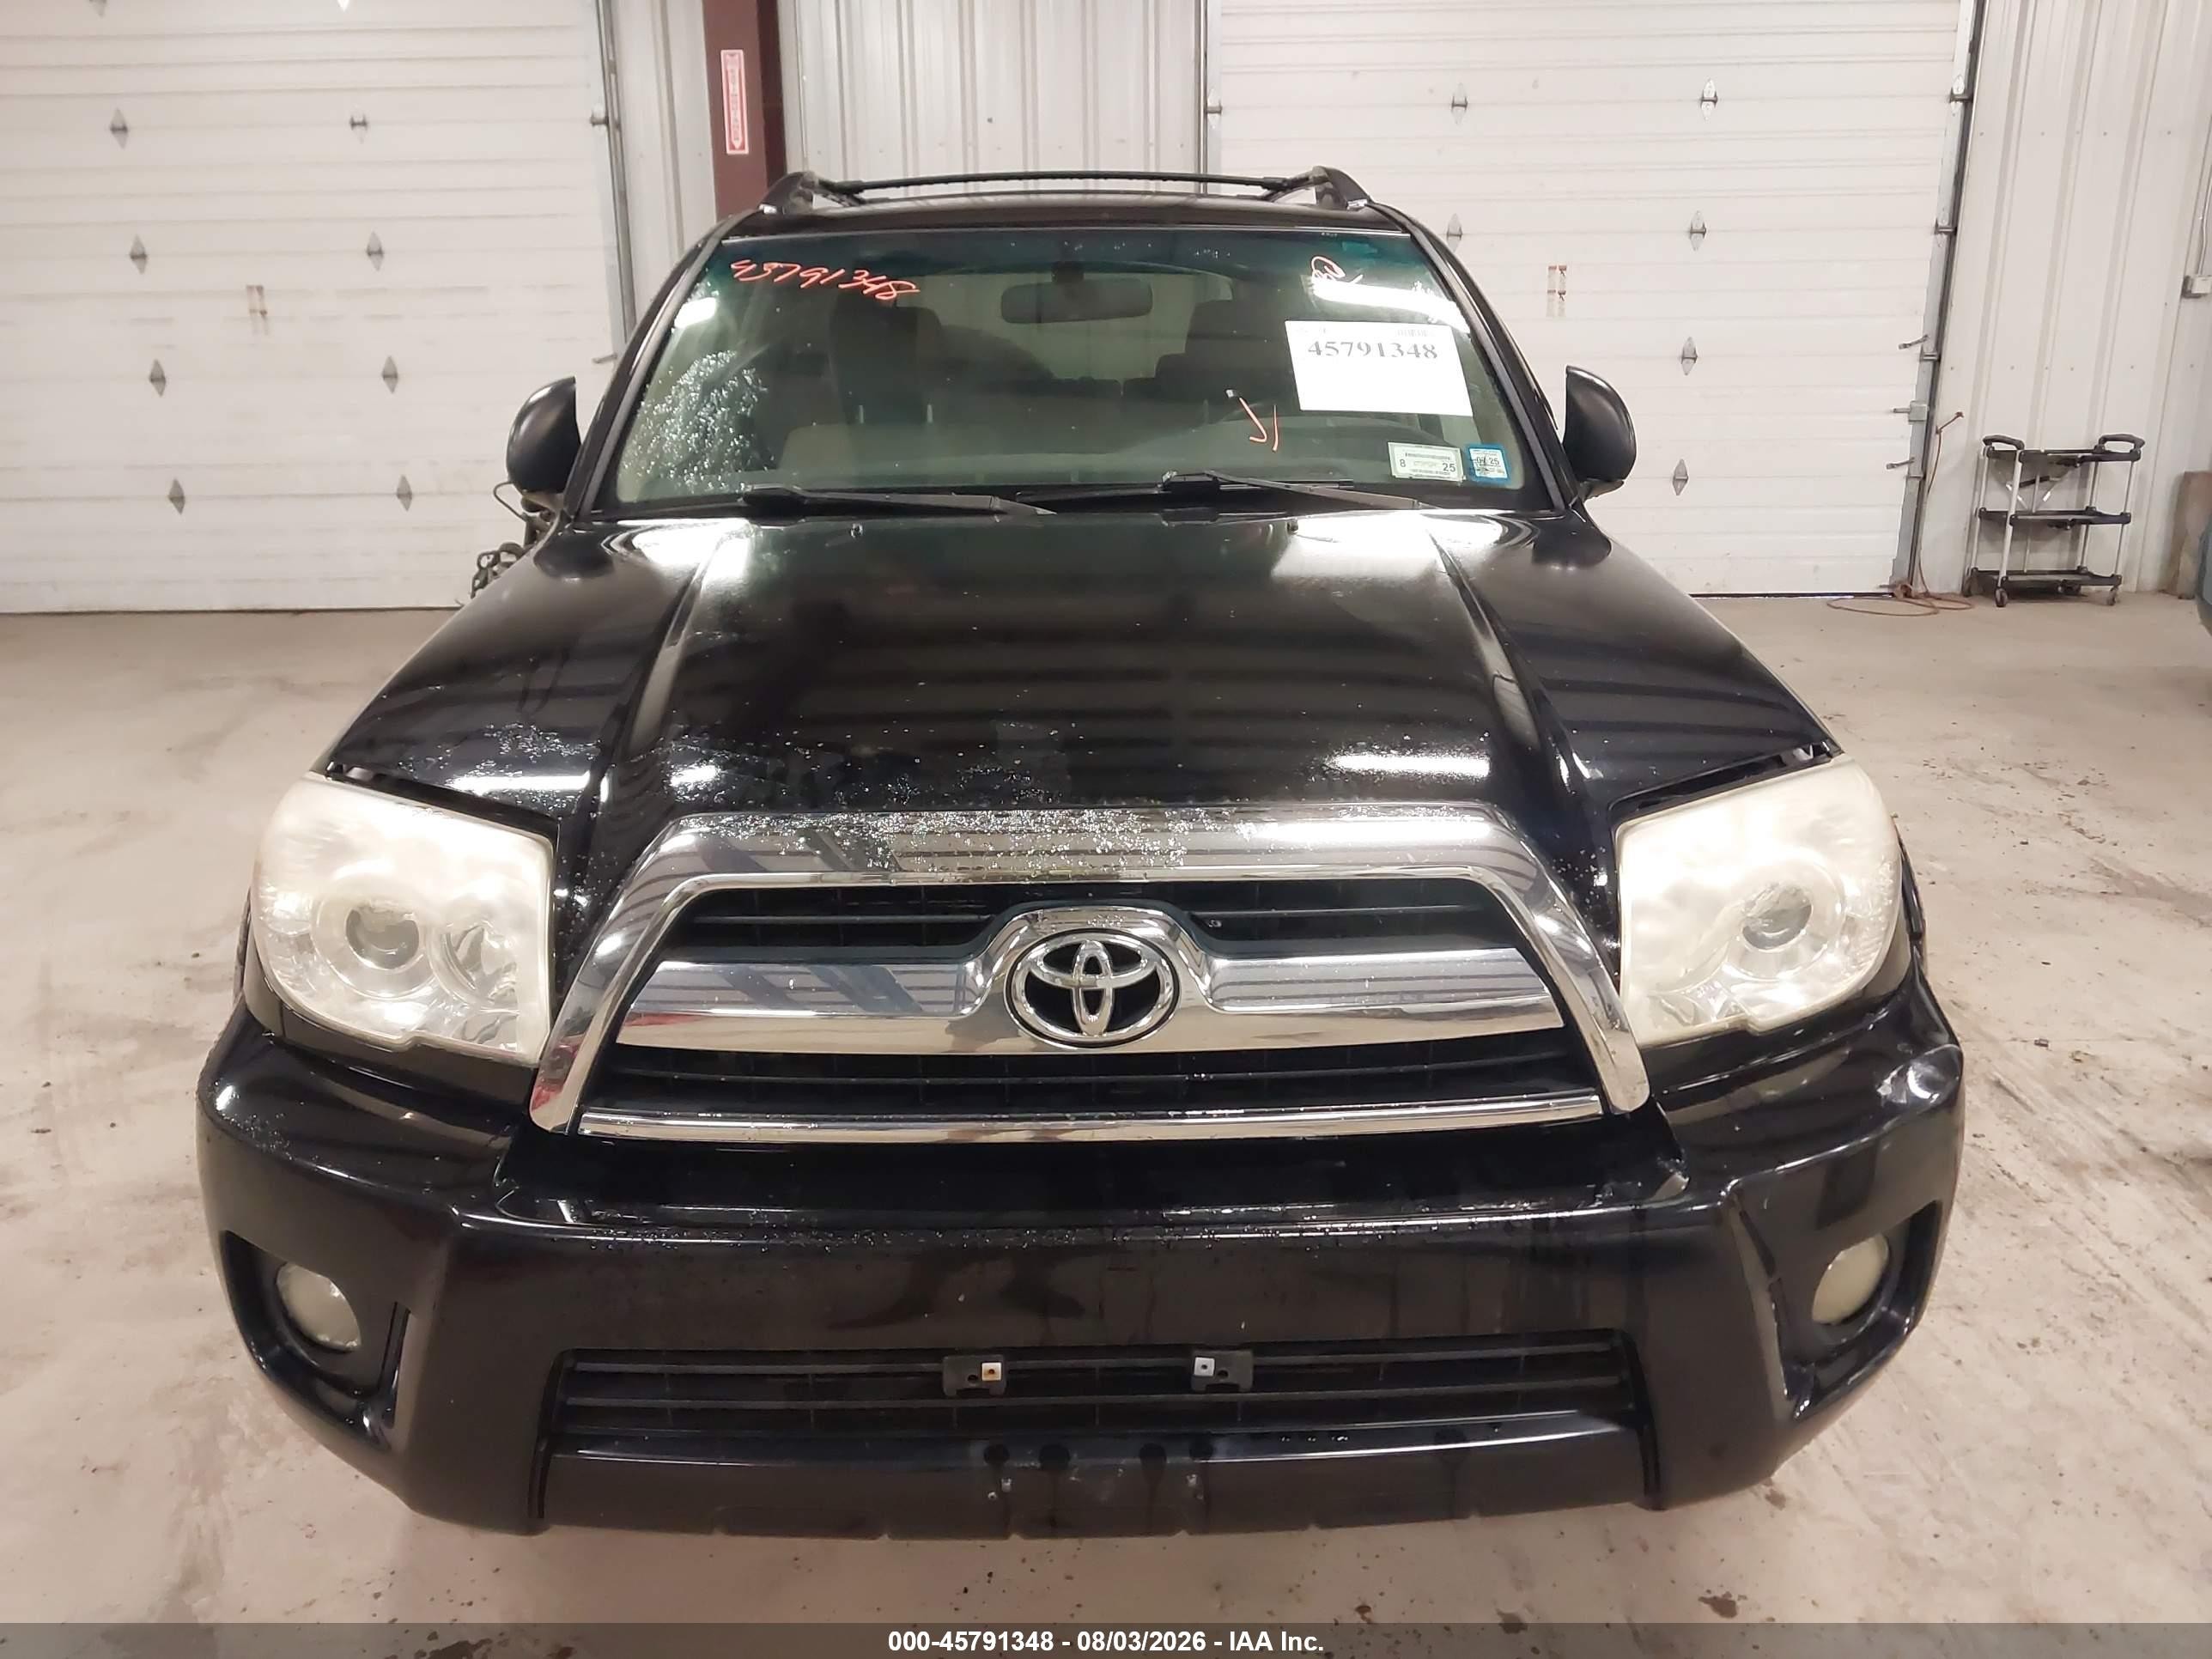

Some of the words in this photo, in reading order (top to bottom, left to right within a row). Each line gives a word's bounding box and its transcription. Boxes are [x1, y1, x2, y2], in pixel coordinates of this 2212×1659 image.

[1308, 340, 1438, 359] 45791348
[1399, 459, 1407, 468] 8
[1442, 462, 1456, 472] 25
